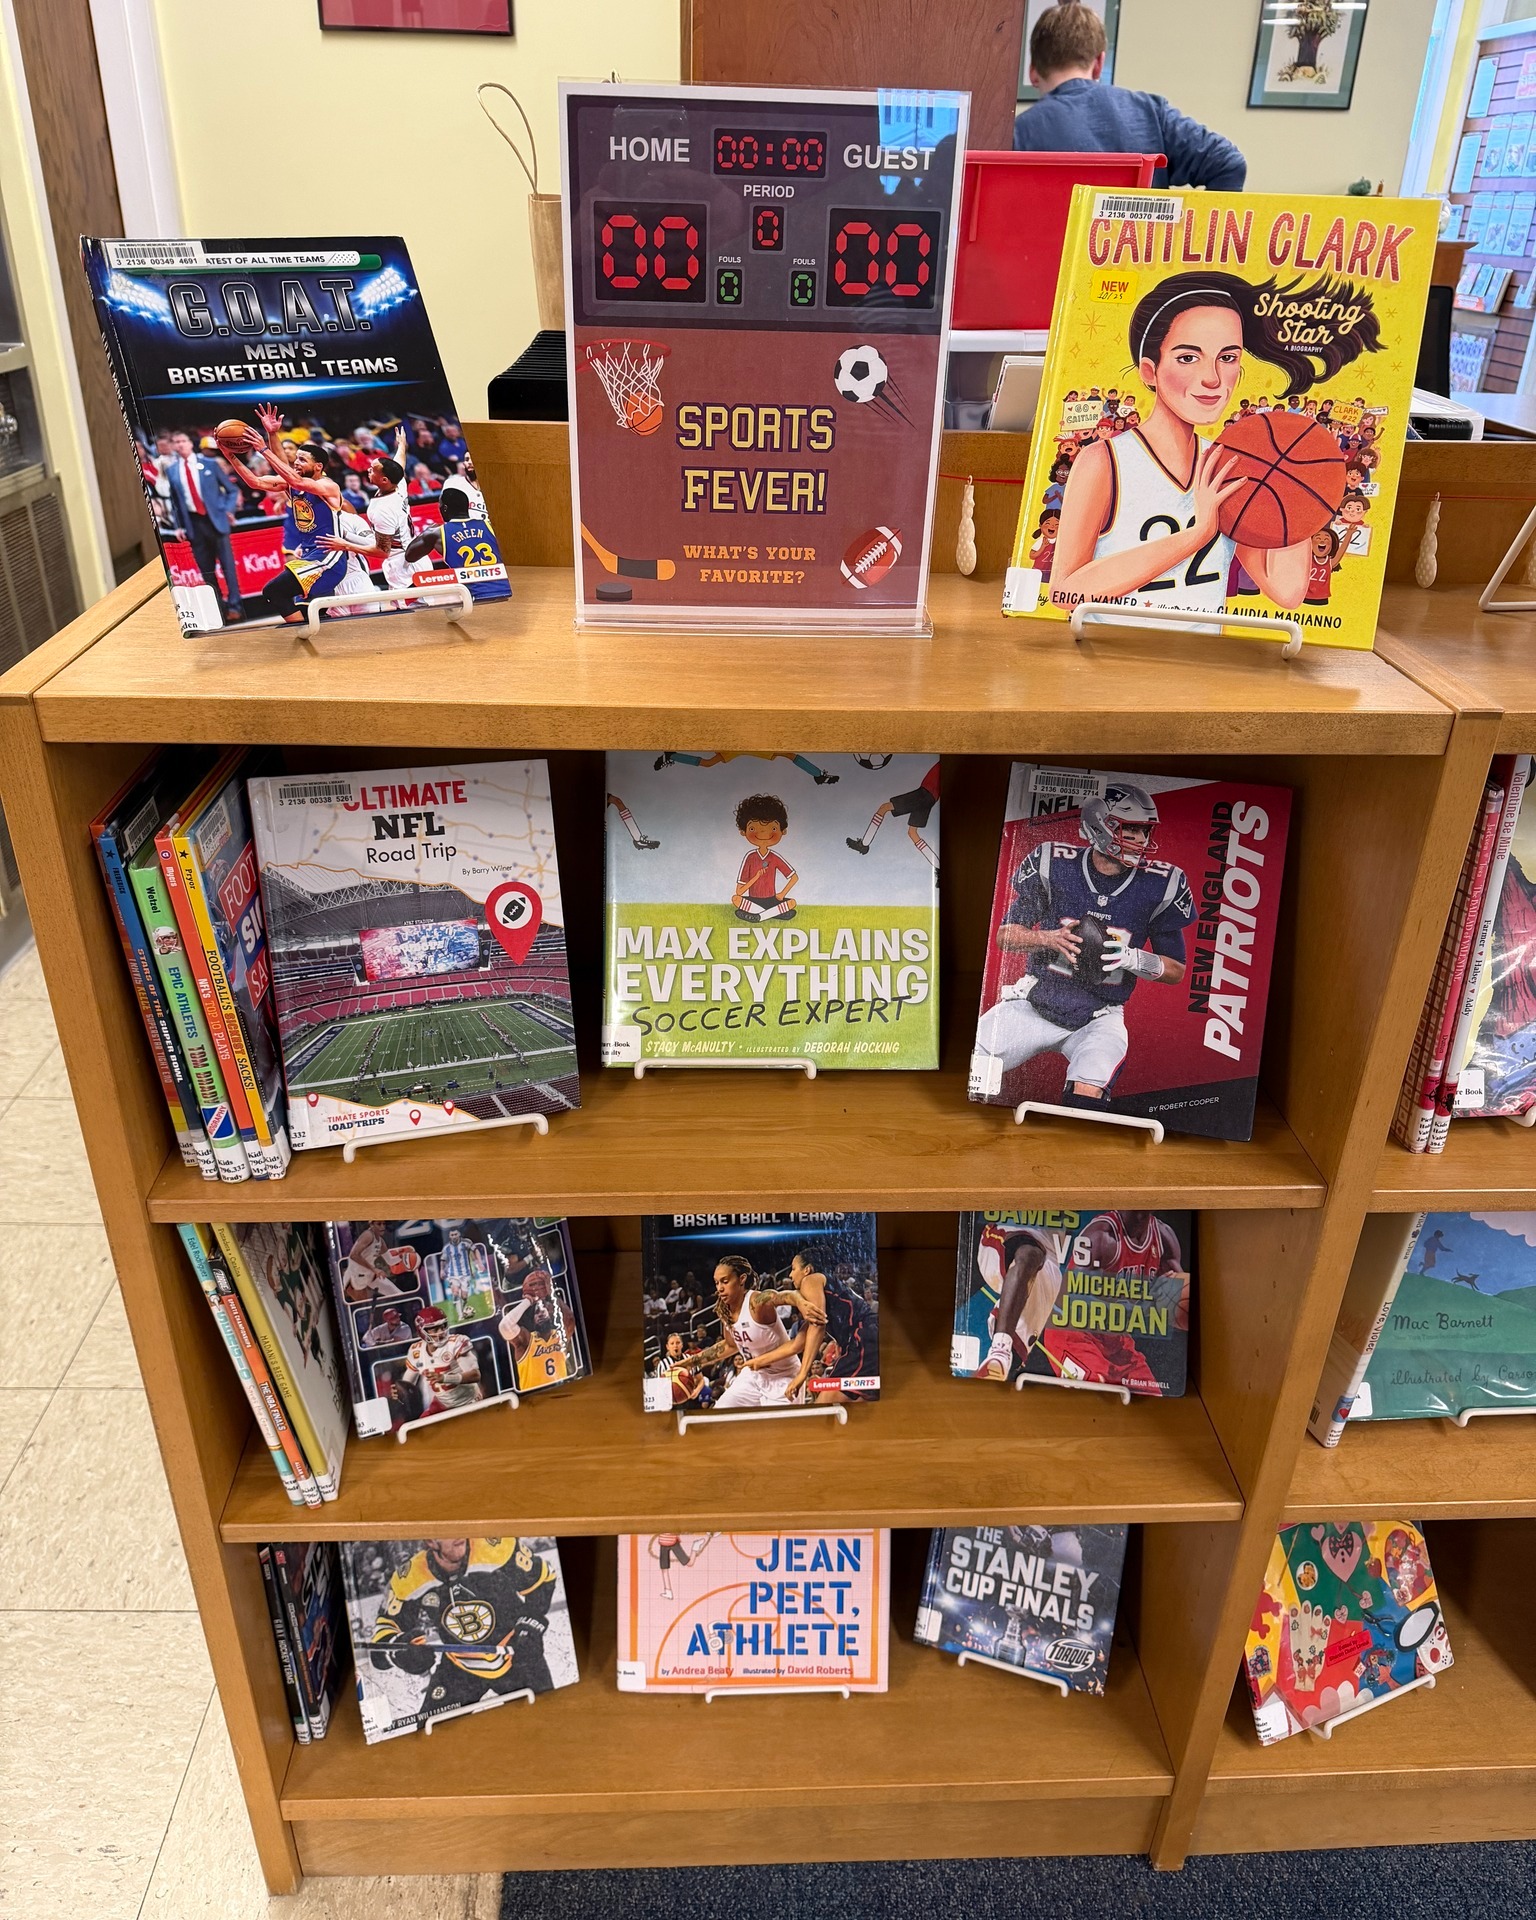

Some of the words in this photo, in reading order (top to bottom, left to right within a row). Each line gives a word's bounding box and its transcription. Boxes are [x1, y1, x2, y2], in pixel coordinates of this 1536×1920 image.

[609, 136, 691, 163] HOME
[717, 135, 823, 171] 00:00
[843, 144, 935, 171] GUEST
[743, 184, 795, 199] PERIOD
[1129, 212, 1152, 220] 00370
[756, 210, 779, 247] 0
[601, 214, 699, 290] 00
[1087, 207, 1254, 267] CAITLIN
[1267, 211, 1415, 283] CLARK
[126, 258, 147, 266] 2136
[234, 256, 249, 264] OF
[251, 256, 268, 264] ALL
[269, 256, 293, 264] TIME
[295, 255, 326, 264] TEAMS
[718, 255, 742, 264] FOULS
[793, 257, 816, 266] FOULS
[834, 221, 931, 297] 00
[720, 272, 739, 301] 0
[793, 273, 813, 304] 0
[1101, 280, 1129, 292] NEW
[168, 278, 372, 337] G.O.A.T.
[1253, 292, 1366, 335] Shooting
[1277, 318, 1335, 346] Star
[244, 341, 317, 361] MEN'S
[1284, 344, 1289, 352] A
[1291, 345, 1324, 353] BIOGRAPHY
[167, 361, 317, 386] BASKETBALL
[321, 357, 398, 376] TEAMS
[1066, 413, 1099, 424] CAITLIN
[1074, 403, 1089, 413] GO
[1333, 405, 1359, 415] CLARK
[676, 402, 837, 453] SPORTS
[681, 466, 829, 515] FEVER!
[451, 528, 484, 544] GREEN
[1336, 528, 1361, 546] 22
[243, 550, 282, 573] Kind
[457, 542, 497, 567] 23
[683, 545, 758, 561] WHAT'S
[767, 546, 816, 561] YOUR
[418, 573, 456, 584] Lerner
[459, 567, 501, 580] SPORTS
[700, 568, 805, 585] FAVORITE?
[1309, 568, 1326, 582] 22
[1038, 594, 1049, 606] by
[1052, 591, 1085, 605] ERICA
[1274, 611, 1342, 629] MARIANNO
[288, 798, 306, 806] 2136
[309, 796, 332, 804] 00338
[336, 795, 353, 803] 5261
[1038, 795, 1080, 816] NFL
[1505, 770, 1526, 819] Valentine
[372, 811, 445, 841] NFL
[1502, 820, 1516, 834] Be
[366, 844, 416, 864] Road
[421, 842, 457, 861] Trip
[1496, 836, 1511, 860] Mine
[165, 866, 178, 888] Myers
[185, 869, 196, 890] Pryor
[462, 868, 471, 876] By
[472, 866, 490, 875] Barry
[491, 864, 513, 873] Wilner
[1196, 800, 1234, 942] ENGLAND
[145, 886, 161, 914] Wetzel
[1203, 800, 1270, 1061] PATRIOTS
[1479, 919, 1492, 948] Farmer
[616, 926, 713, 960] MAX
[728, 927, 929, 962] EXPLAINS
[137, 948, 152, 981] STARS
[1468, 959, 1484, 985] Halsey
[168, 966, 184, 989] EPIC
[197, 978, 211, 999] NFL's
[619, 963, 929, 1004] EVERYTHING
[1188, 943, 1215, 1013] NEW
[147, 982, 158, 997] OF
[152, 997, 164, 1018] THE
[175, 991, 198, 1039] ATHLETES
[204, 1000, 219, 1020] TOP
[632, 1004, 767, 1036] SOCCER
[778, 995, 912, 1027] EXPERT
[1461, 997, 1474, 1017] Addy
[207, 949, 232, 1011] FOOTBALL'S
[224, 1012, 246, 1060] SICKEST
[237, 1058, 256, 1091] SACKS!
[210, 1020, 222, 1030] 10
[159, 1019, 175, 1053] SUPER
[213, 1031, 231, 1061] PLAYS
[645, 1040, 680, 1053] STACY
[803, 1041, 851, 1054] DEBORAH
[853, 1041, 900, 1054] HOCKING
[169, 1053, 184, 1083] BOWL
[187, 1044, 205, 1069] TOM
[194, 1068, 221, 1105] BRADY
[1465, 1088, 1483, 1096] Book
[360, 1108, 390, 1119] SPORTS
[1149, 1105, 1159, 1113] BY
[1160, 1101, 1188, 1111] ROBERT
[1189, 1097, 1219, 1108] COOPER
[354, 1117, 385, 1128] TRIPS
[673, 1213, 781, 1227] BASKETBALL
[1052, 1233, 1100, 1267] VS.
[1067, 1271, 1153, 1301] MICHAEL
[227, 1298, 241, 1317] SPORTS
[234, 1313, 252, 1349] CHAMPIONSHIPS
[1052, 1295, 1168, 1337] JORDAN
[1377, 1301, 1392, 1325] Love,
[1393, 1314, 1429, 1330] Mac
[1436, 1312, 1494, 1330] Barnett
[217, 1311, 252, 1380] SERGIO
[545, 1358, 555, 1376] 6
[1391, 1367, 1462, 1385] illustrated
[1472, 1364, 1490, 1388] by
[259, 1381, 271, 1397] THE
[271, 1364, 284, 1383] BEST
[278, 1381, 293, 1399] GAME
[813, 1380, 840, 1389] Lerner
[843, 1379, 876, 1387] SPORTS
[1130, 1379, 1147, 1387] BRIAN
[1148, 1380, 1170, 1389] HOWELL
[263, 1395, 276, 1412] NBA
[269, 1410, 287, 1431] FINALS
[975, 1526, 1003, 1545] THE
[756, 1538, 861, 1572] JEAN
[951, 1536, 1099, 1602] STANLEY
[750, 1581, 860, 1618] PEET,
[946, 1567, 995, 1600] CUP
[998, 1581, 1094, 1631] FINALS
[686, 1623, 859, 1656] ATHLETE
[1048, 1643, 1094, 1666] TORQUE
[661, 1667, 670, 1676] by
[672, 1665, 705, 1675] Andrea
[707, 1666, 734, 1677] Beaty
[743, 1667, 776, 1675] illustrated
[777, 1668, 785, 1676] by
[787, 1665, 814, 1675] David
[816, 1665, 853, 1675] Roberts
[397, 1716, 417, 1727] RYAN
